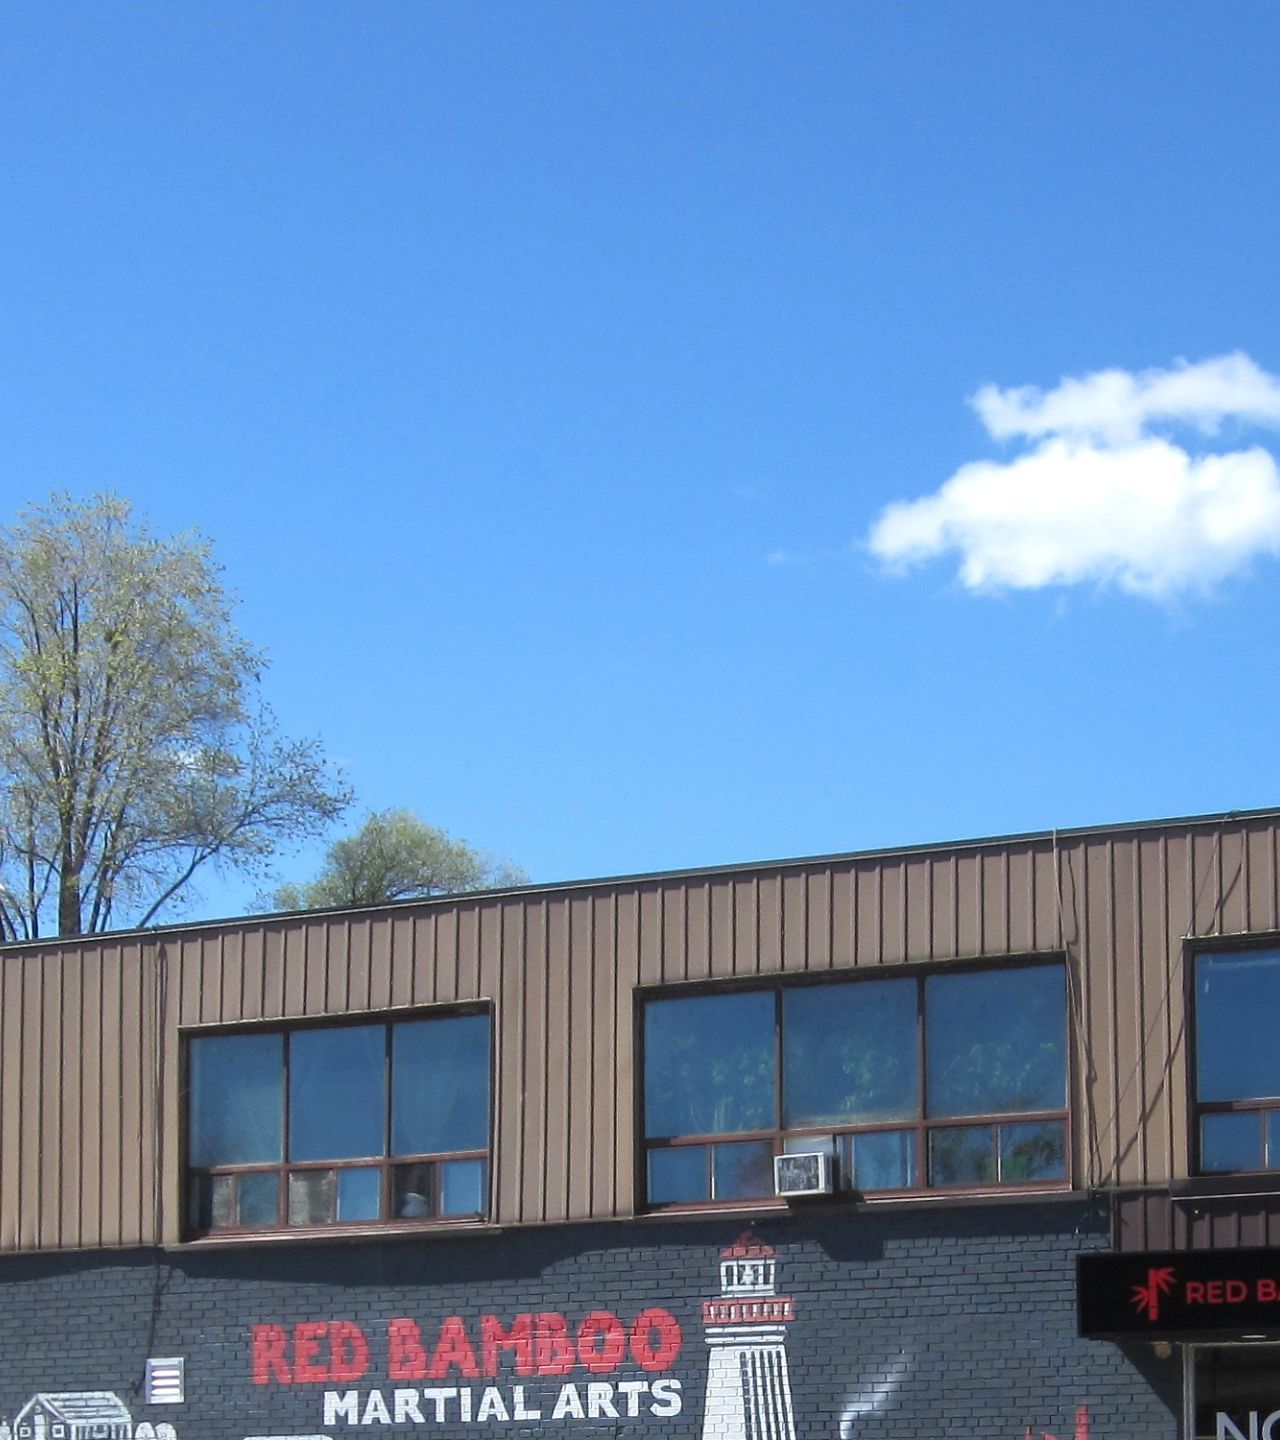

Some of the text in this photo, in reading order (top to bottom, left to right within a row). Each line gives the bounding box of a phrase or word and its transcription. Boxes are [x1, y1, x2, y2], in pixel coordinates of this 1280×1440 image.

[1186, 1280, 1248, 1304] RED
[250, 1308, 683, 1385] RED BAMBOO
[323, 1379, 683, 1426] MARTIAL ARTS
